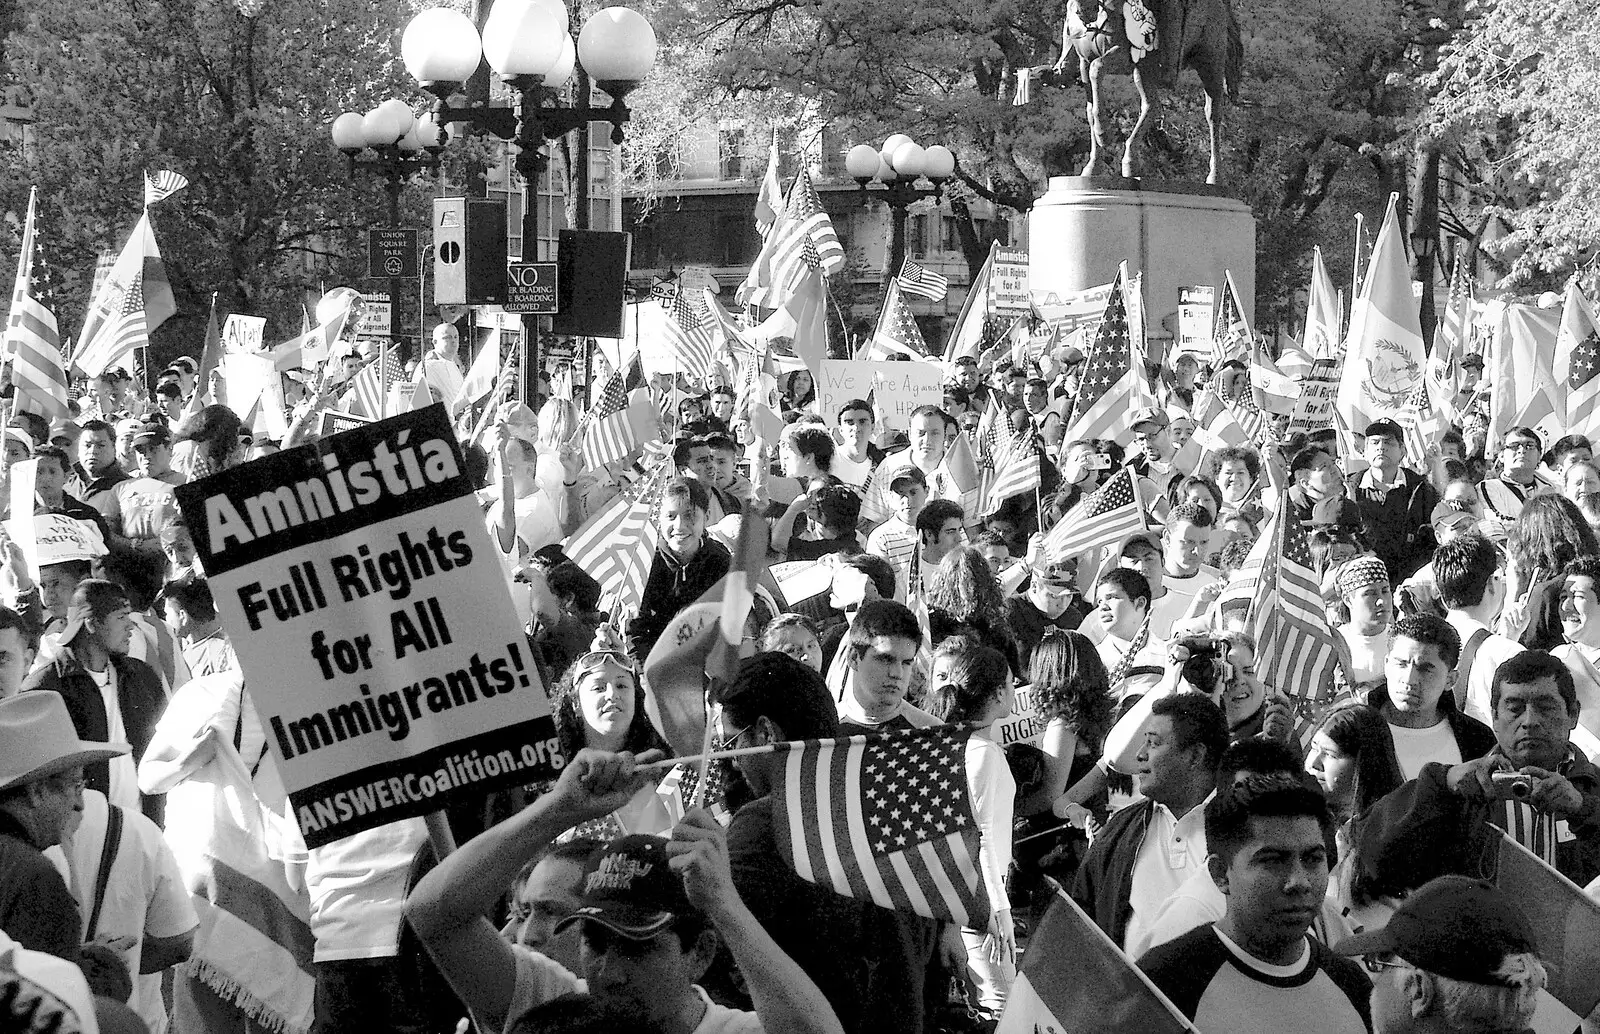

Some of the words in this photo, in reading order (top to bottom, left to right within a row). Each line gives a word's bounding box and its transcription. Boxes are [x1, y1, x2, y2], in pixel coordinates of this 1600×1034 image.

[379, 240, 407, 248] SQUARE
[508, 266, 538, 287] NO
[996, 266, 1008, 277] Full
[1010, 267, 1027, 280] Rights
[519, 285, 553, 293] BLADING
[1002, 279, 1013, 290] for
[514, 294, 554, 302] BOARDING
[995, 292, 1029, 304] Immigrants!
[504, 303, 540, 311] ALLOWED
[825, 367, 855, 390] We
[869, 370, 897, 391] Are
[1303, 384, 1320, 397] Full
[1304, 401, 1318, 414] for
[205, 427, 460, 554] Amnistía
[237, 560, 328, 632] Full
[329, 525, 473, 604] Rights
[310, 630, 372, 680] for
[390, 596, 453, 660] All
[269, 642, 531, 761] Immigrants!
[1000, 717, 1038, 745] RIGH
[299, 736, 565, 836] ANSWERCoalition.org
